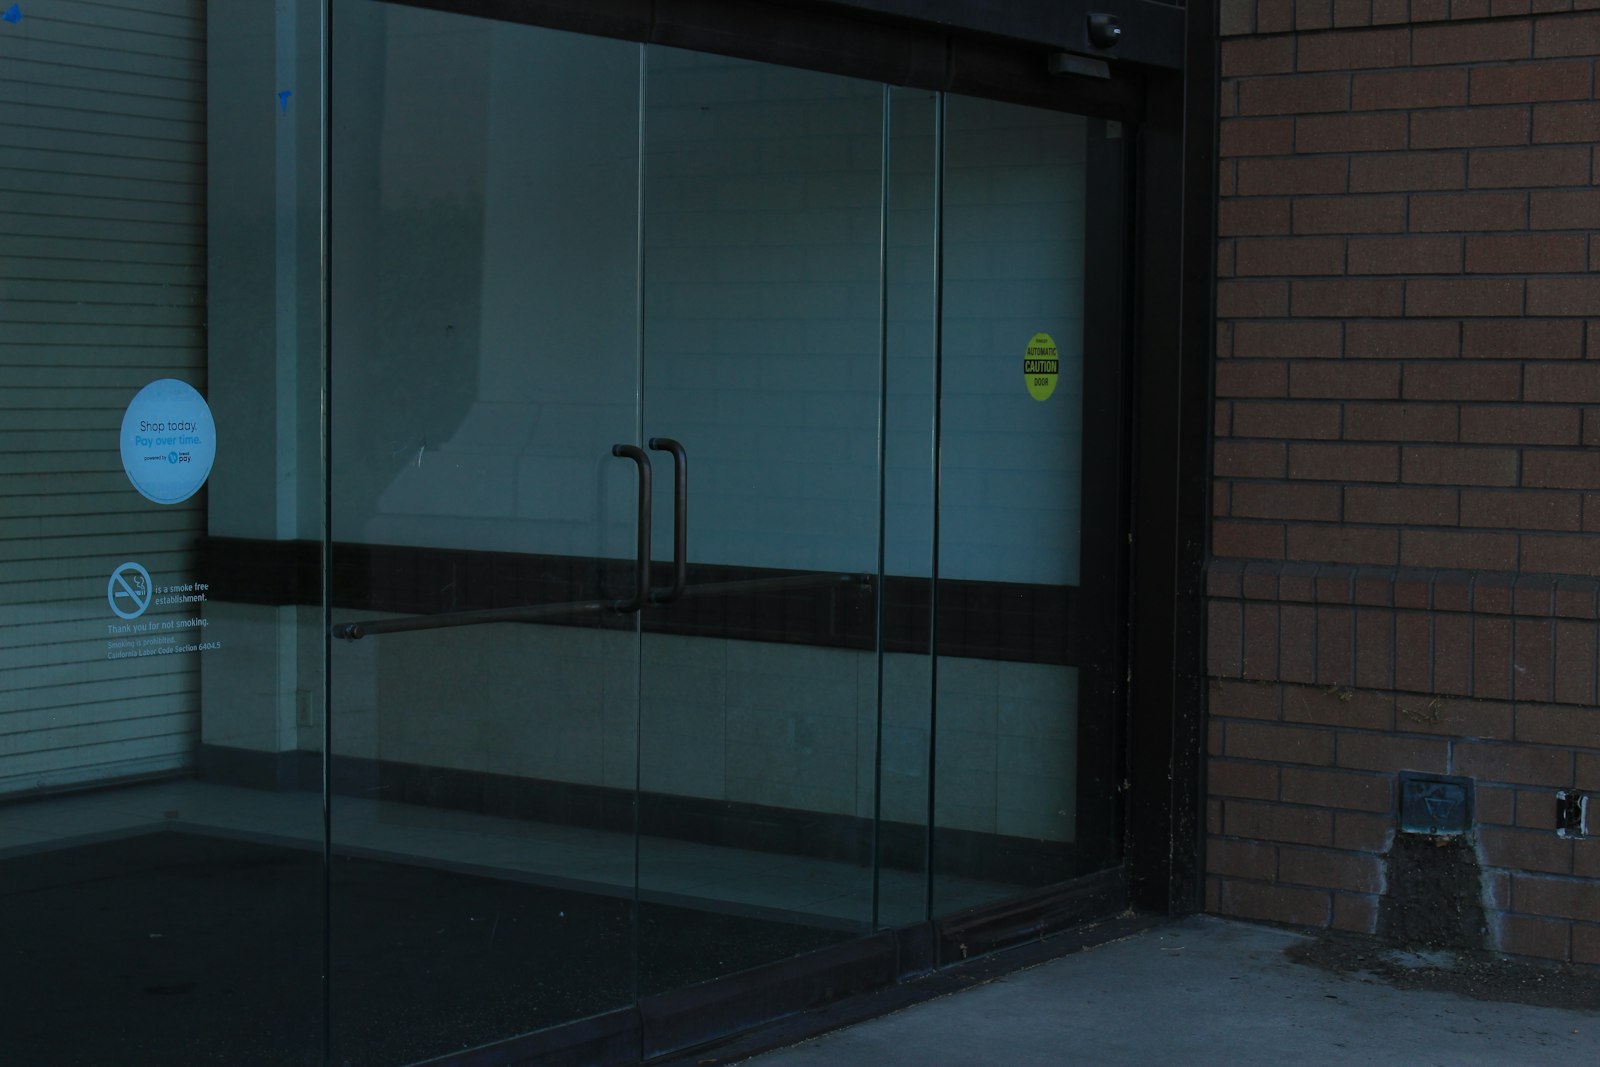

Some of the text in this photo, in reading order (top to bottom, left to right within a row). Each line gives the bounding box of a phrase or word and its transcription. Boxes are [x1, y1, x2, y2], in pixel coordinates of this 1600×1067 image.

[1027, 347, 1057, 356] AUTOMATIC
[1025, 361, 1057, 372] CAUTION
[1034, 378, 1048, 386] DOOR
[140, 420, 197, 433] Shop today.
[135, 435, 202, 448] Pay over time.
[155, 585, 162, 593] is
[170, 584, 193, 593] smoke
[194, 582, 209, 591] free
[155, 594, 207, 604] establishment.
[108, 617, 209, 633] Thank you for not smoking.
[108, 639, 135, 649] Smoking
[143, 637, 176, 647] prohibited.
[108, 641, 221, 659] California Labor Code Section 6404.5
